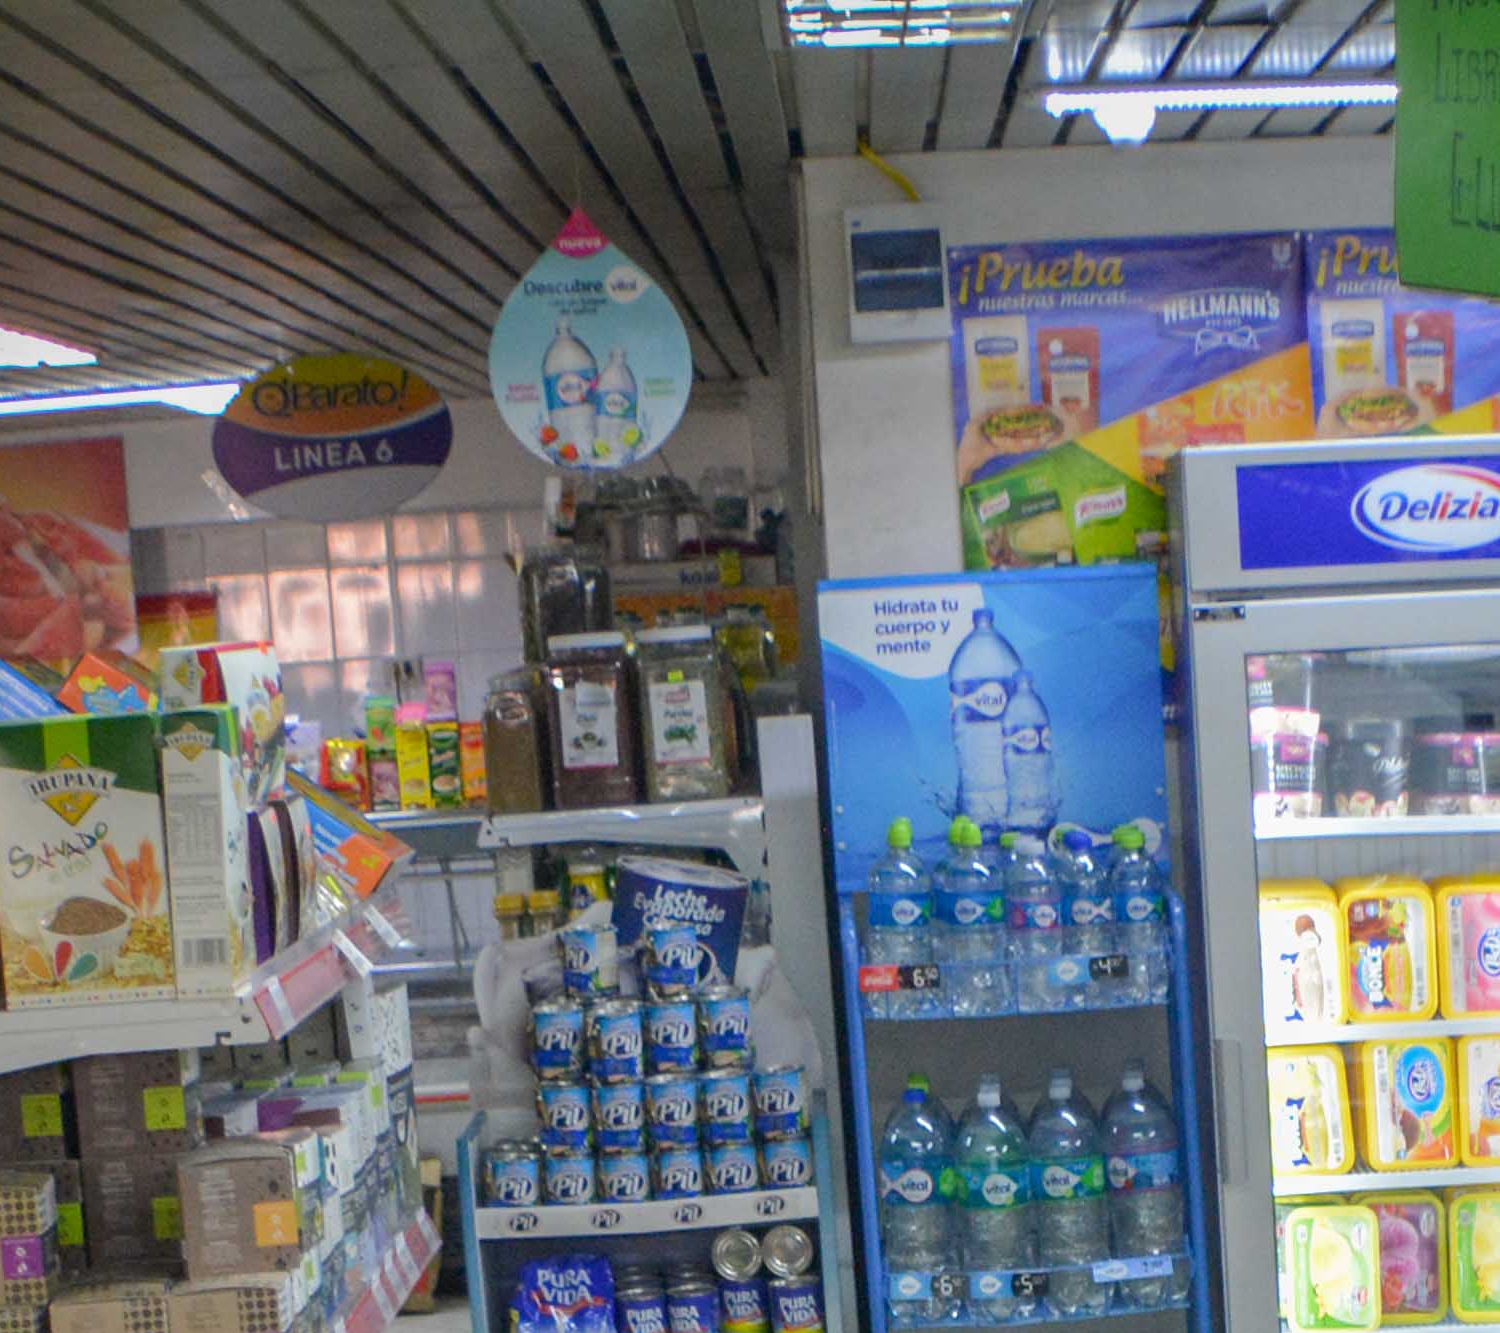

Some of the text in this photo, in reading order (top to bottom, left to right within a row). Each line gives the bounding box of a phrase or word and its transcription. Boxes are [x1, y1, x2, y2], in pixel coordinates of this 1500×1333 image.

[959, 252, 1124, 305] ¡Prueba
[524, 281, 603, 298] Descubre
[979, 293, 1054, 312] nuestras
[1163, 290, 1281, 325] HELLMANN'S
[274, 443, 394, 471] LINEA 6
[873, 598, 959, 617] Hidrata tu
[875, 619, 952, 637] cuerpo y
[876, 637, 931, 655] mente
[975, 692, 1003, 707] vital
[28, 769, 117, 797] IRUPANA
[653, 884, 707, 912] Leche
[663, 945, 698, 967] Pil
[658, 1020, 695, 1044] Pil
[716, 1015, 748, 1036] Pil
[542, 1029, 579, 1051] Pil
[608, 1034, 641, 1056] Pil
[551, 1101, 586, 1127] Pil
[605, 1101, 639, 1124] Pil
[658, 1099, 692, 1122] Pil
[709, 1093, 745, 1116] Pil
[901, 1178, 930, 1193] vital
[984, 1182, 1012, 1197] vital
[1044, 1174, 1072, 1189] vital
[537, 1269, 591, 1288] PURA
[542, 1285, 591, 1304] VIDA
[723, 1289, 760, 1307] PURA
[779, 1295, 816, 1313] PURA
[626, 1308, 663, 1326] PURA
[728, 1301, 762, 1318] VIDA
[782, 1307, 818, 1325] VIDA
